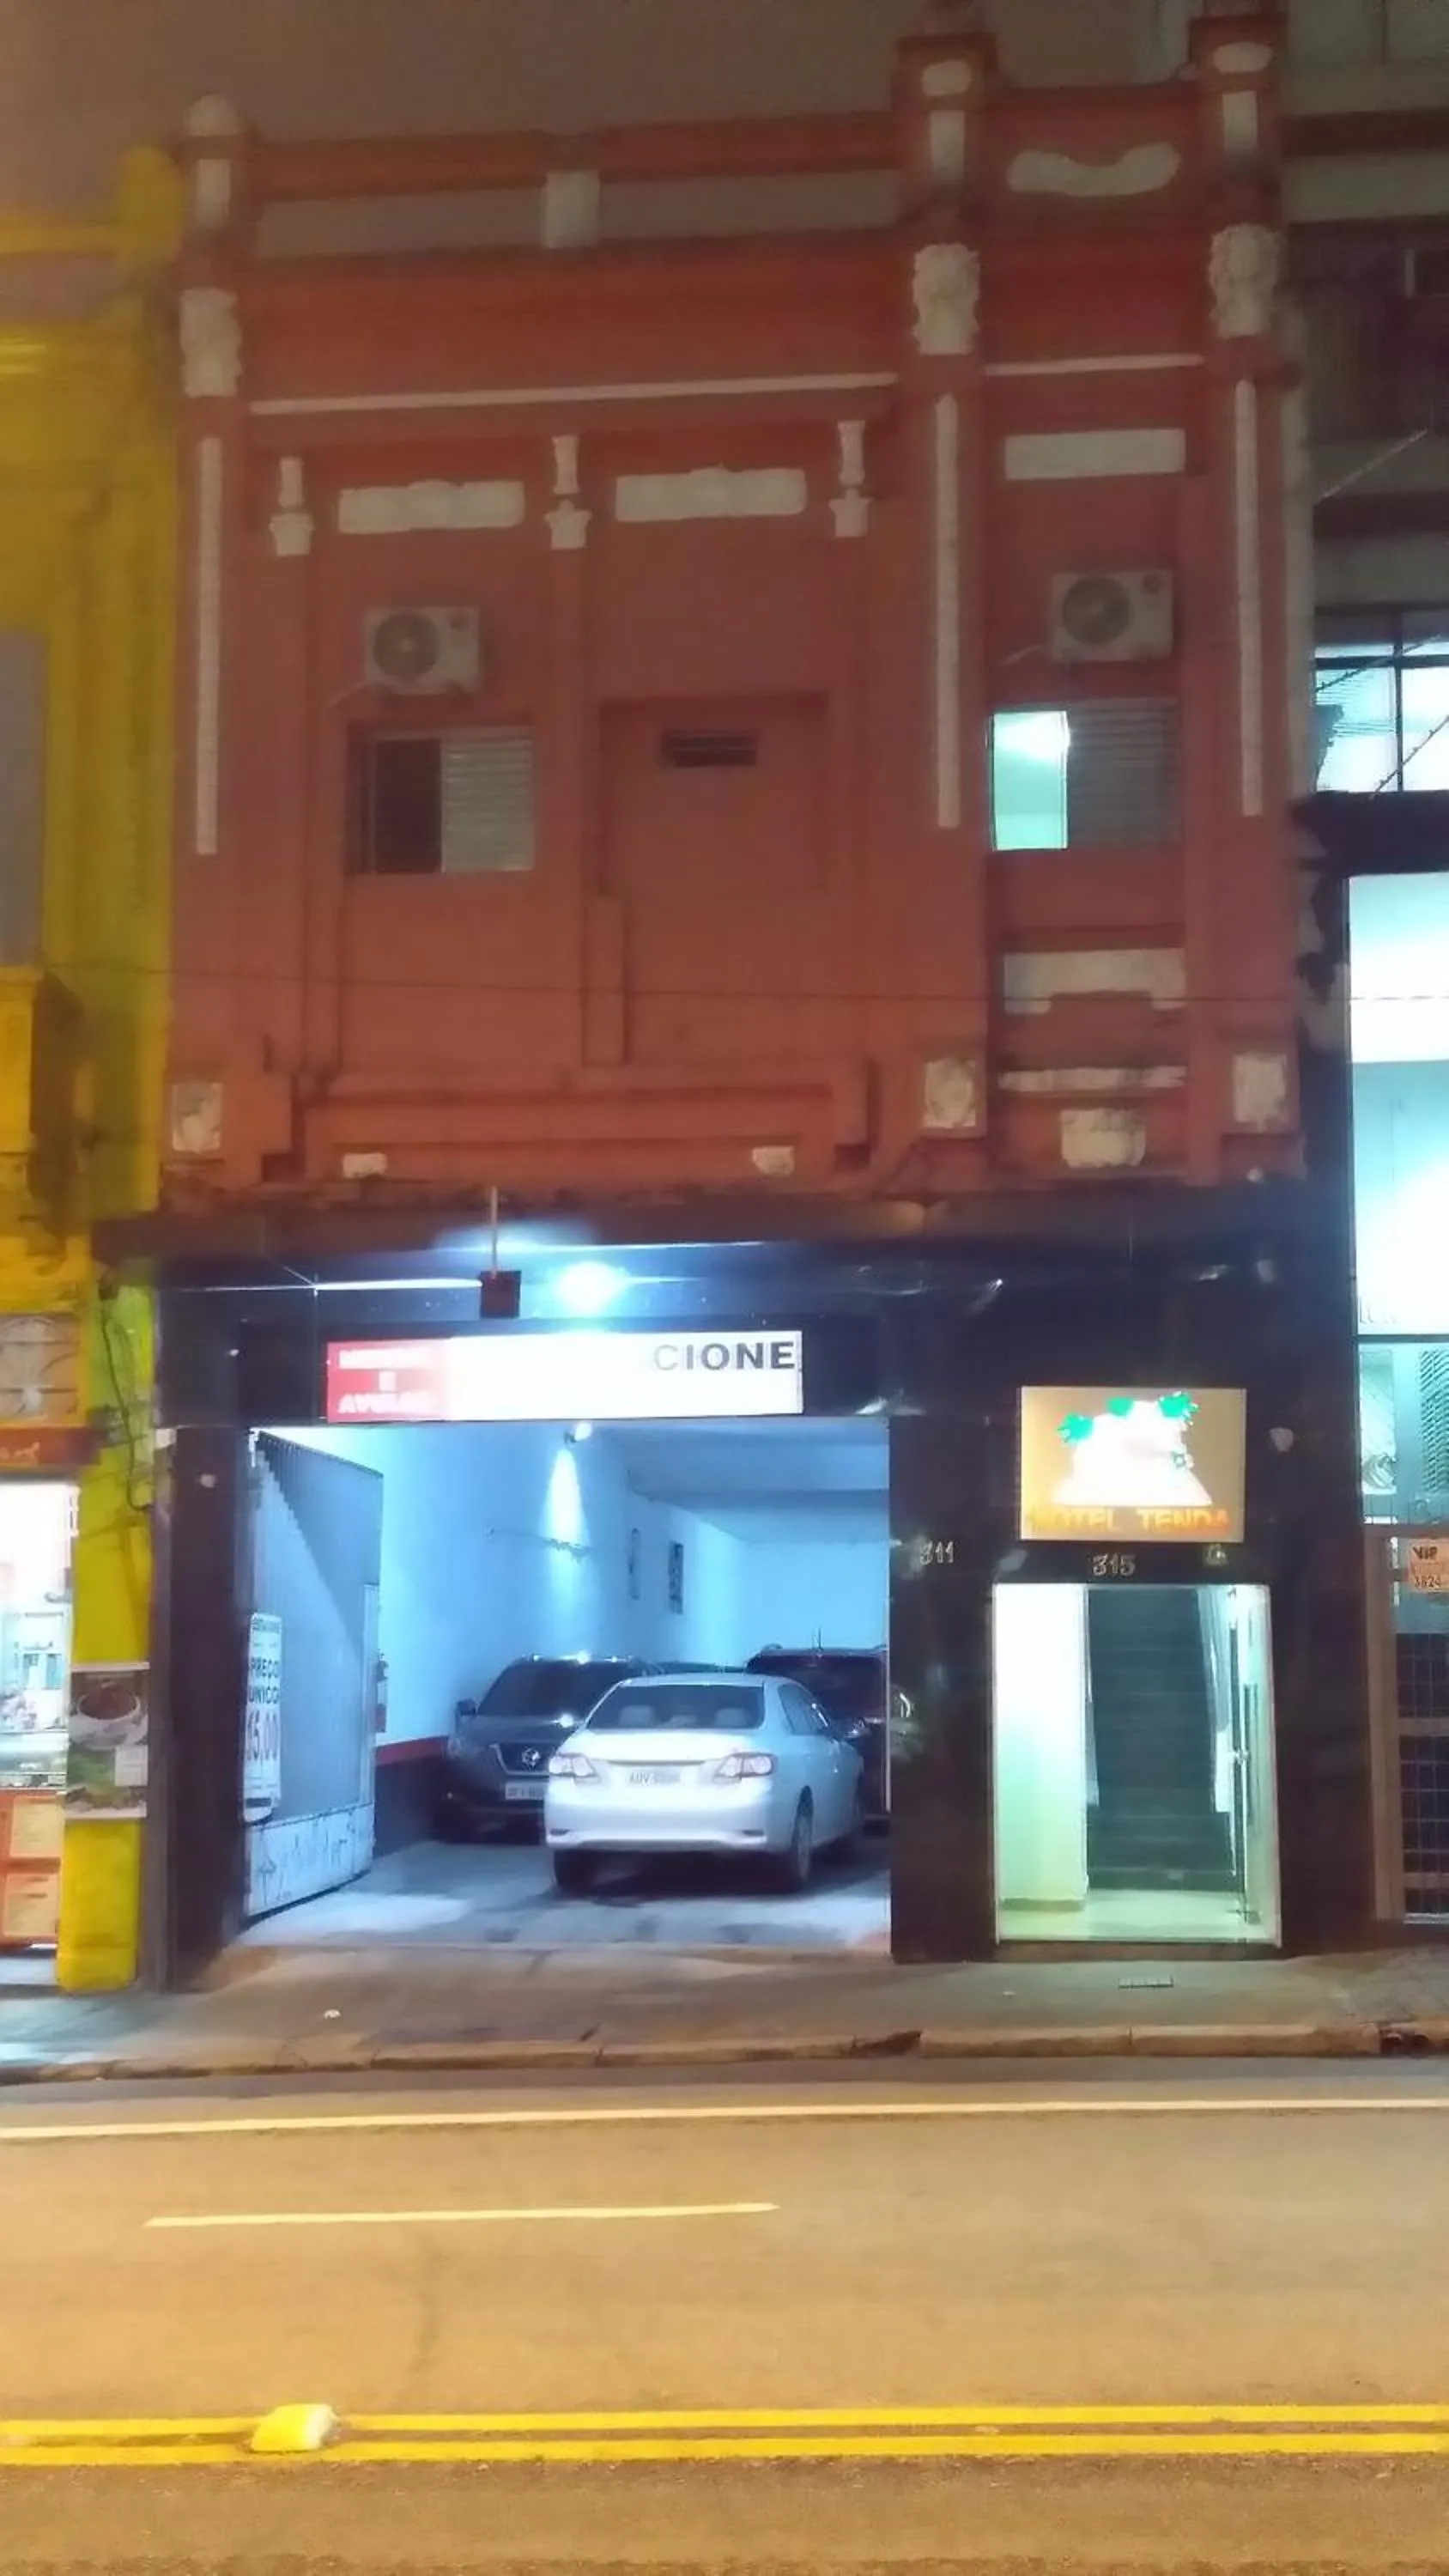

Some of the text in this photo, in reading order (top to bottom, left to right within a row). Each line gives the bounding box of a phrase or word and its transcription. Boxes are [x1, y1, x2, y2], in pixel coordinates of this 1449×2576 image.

[1030, 1508, 1230, 1534] OTEL TENDA
[919, 1540, 954, 1564] 311
[1412, 1546, 1438, 1560] VIP
[1093, 1553, 1136, 1576] 315
